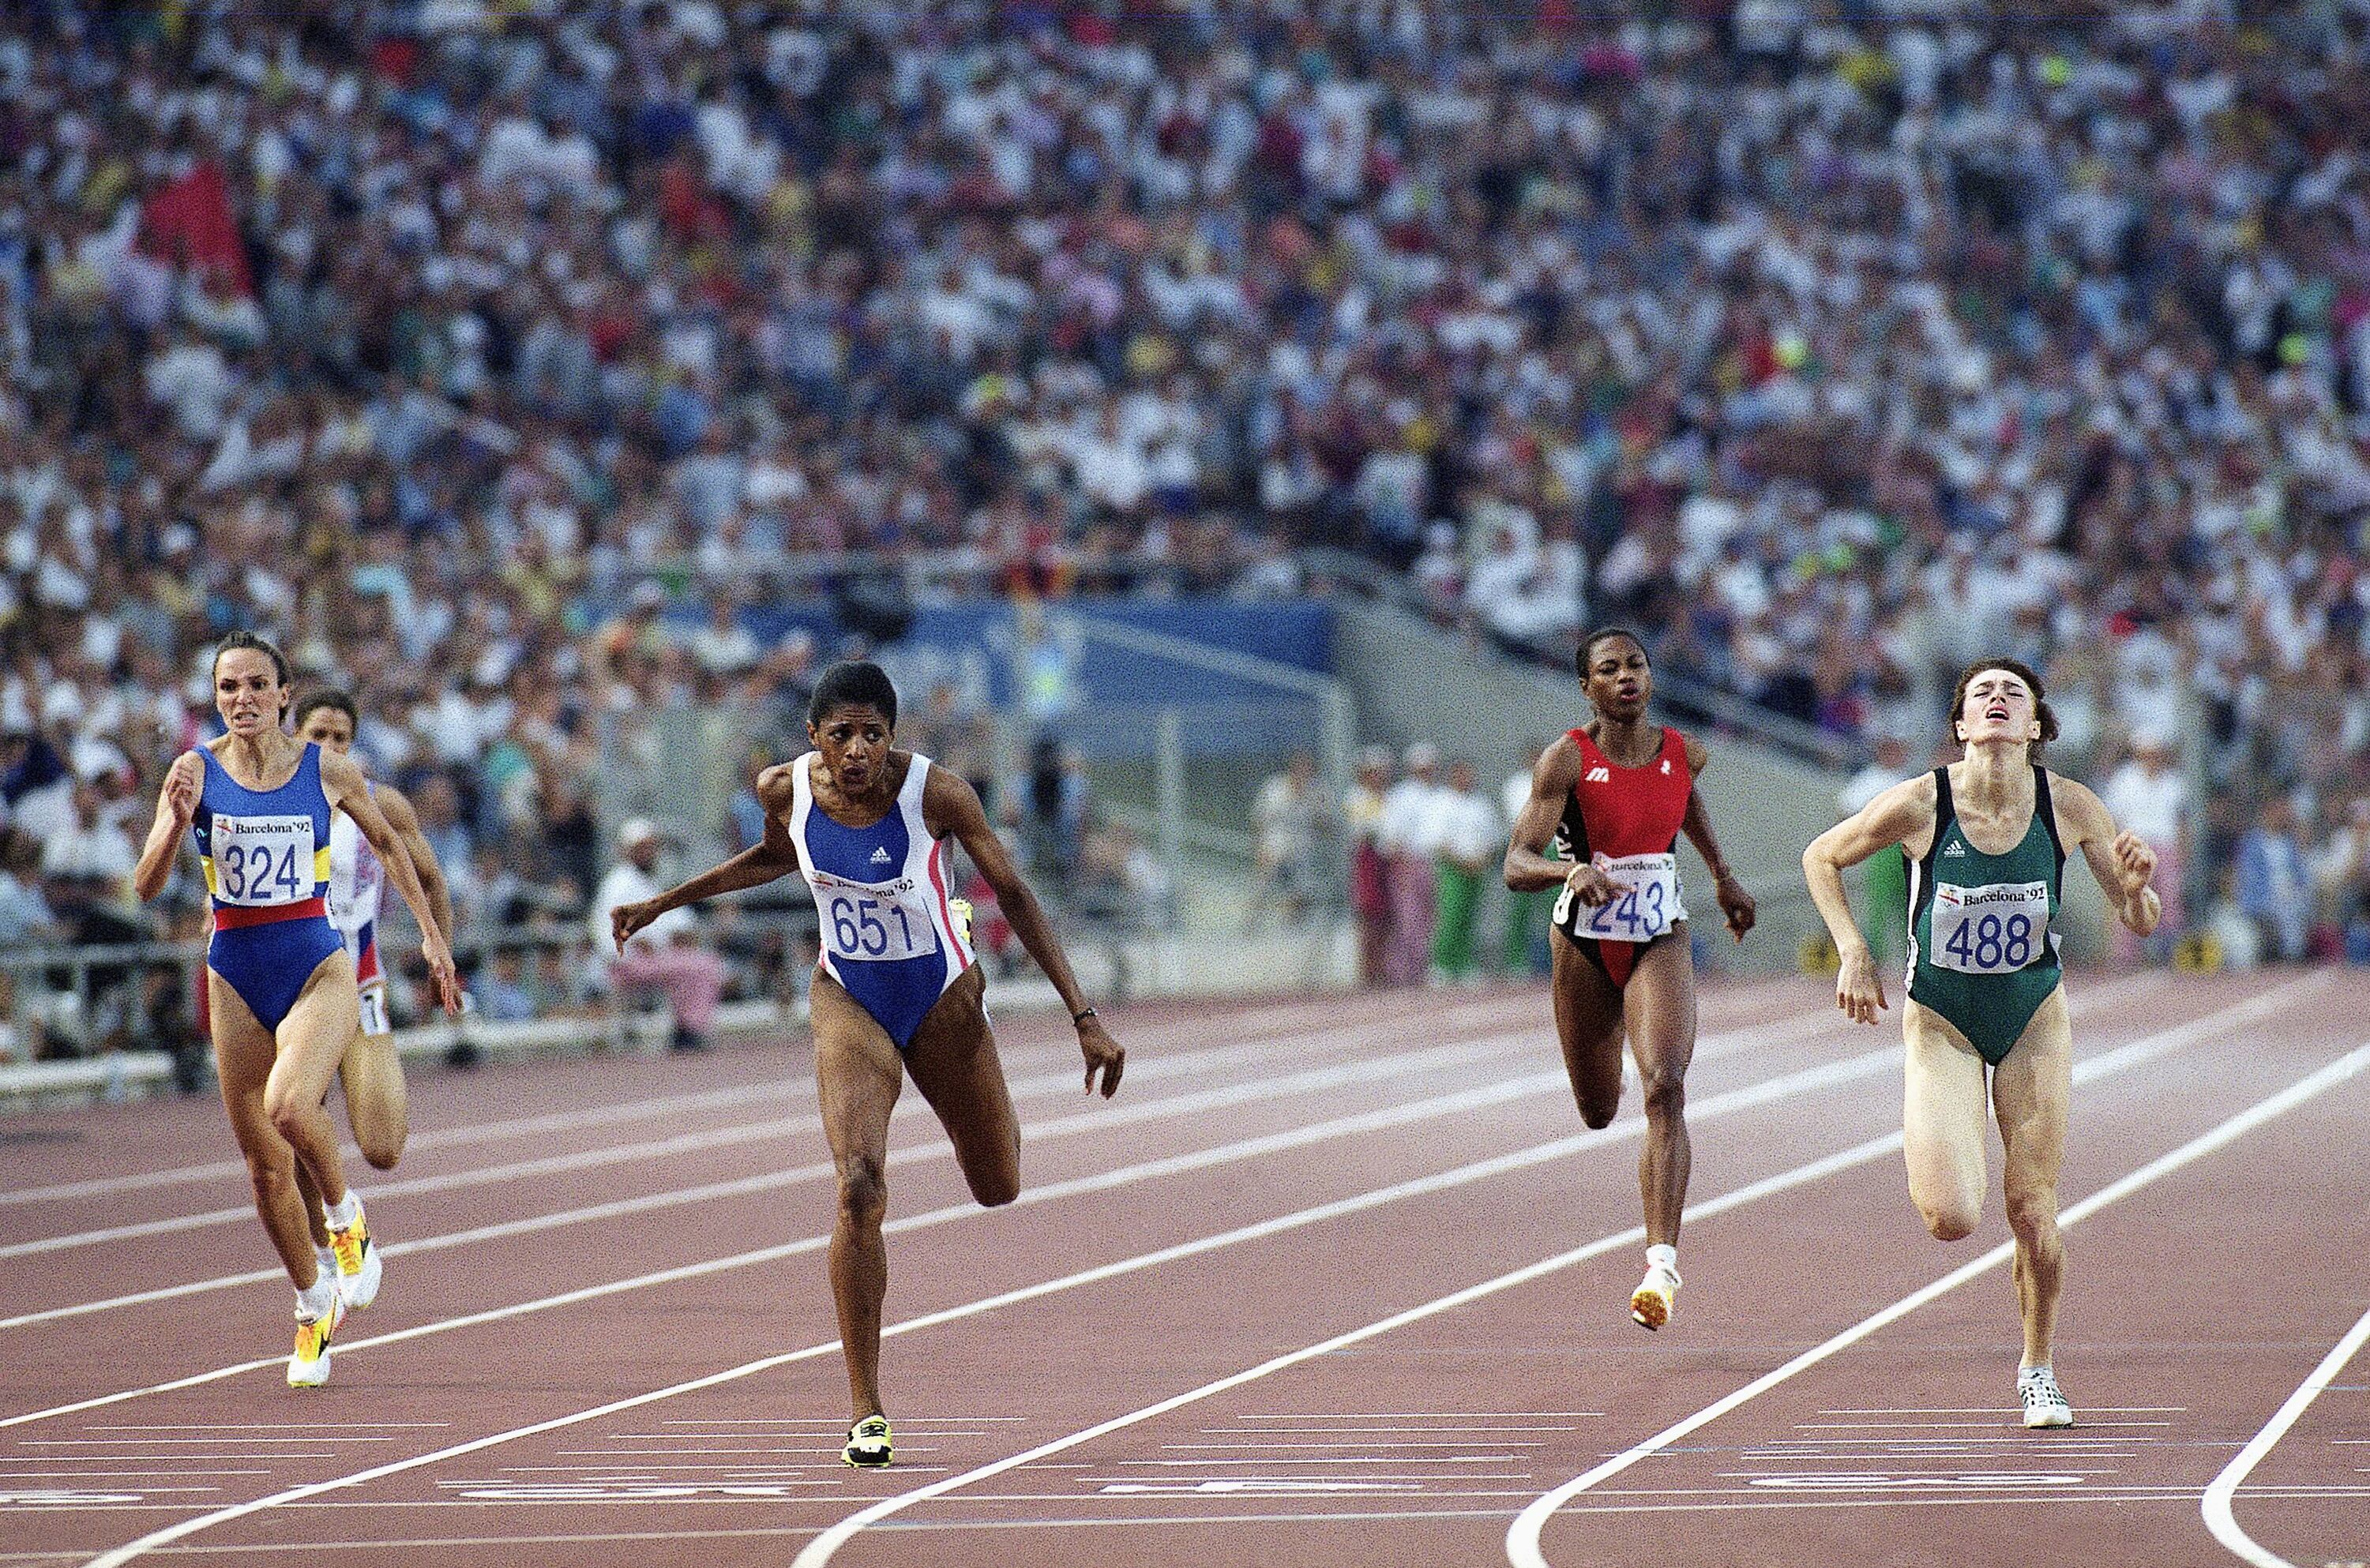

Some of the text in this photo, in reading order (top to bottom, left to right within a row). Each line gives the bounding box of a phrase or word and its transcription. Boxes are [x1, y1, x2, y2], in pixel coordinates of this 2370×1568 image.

[225, 844, 300, 899] 324
[831, 896, 913, 956] 651
[1591, 881, 1663, 936] 243
[1945, 913, 2031, 970] 488
